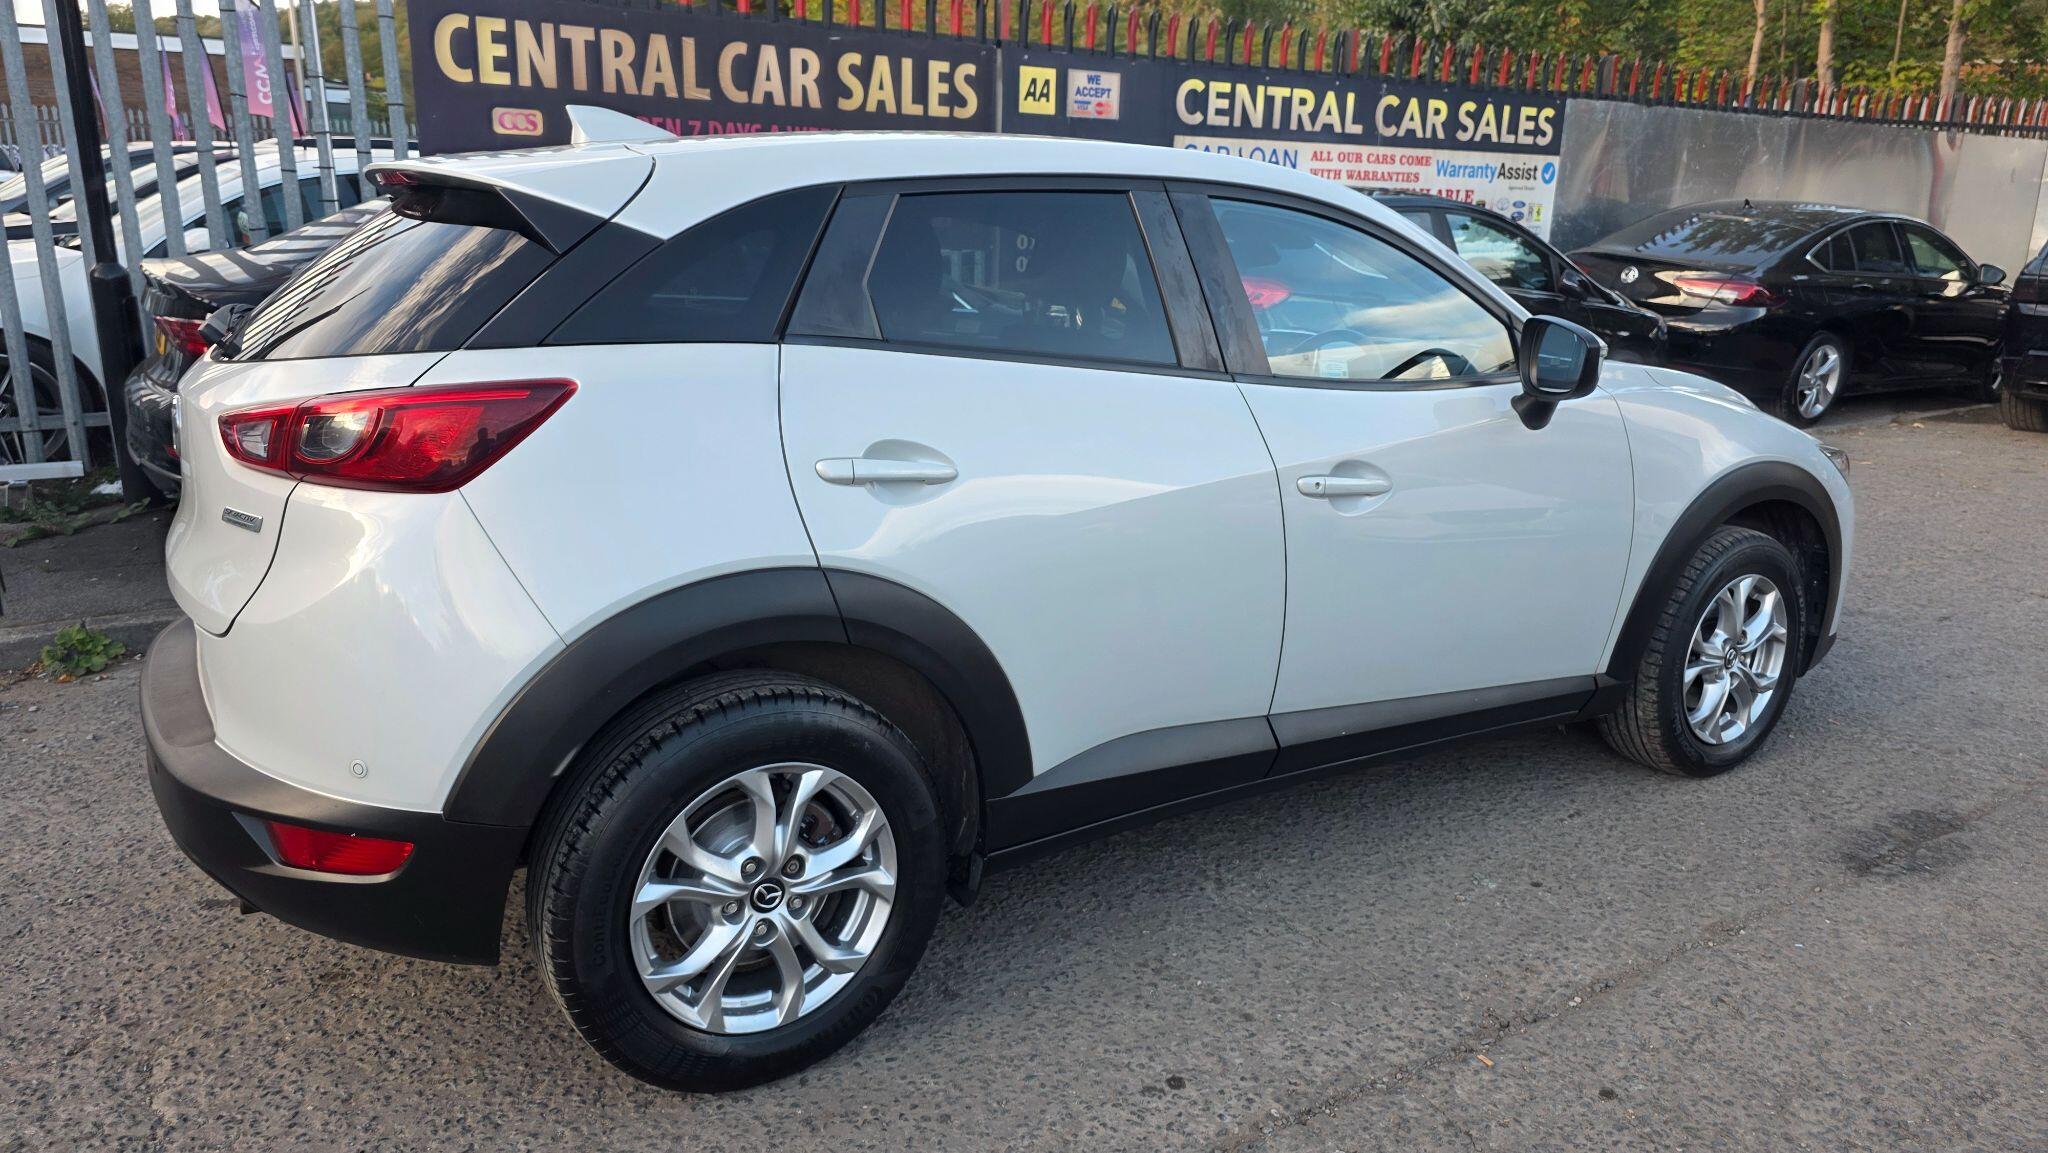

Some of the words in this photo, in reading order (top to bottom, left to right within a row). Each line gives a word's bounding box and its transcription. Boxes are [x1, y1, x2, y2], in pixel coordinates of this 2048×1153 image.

[434, 13, 711, 100] CENTRAL
[718, 41, 822, 109] CAR
[837, 52, 978, 119] SALES
[1086, 74, 1101, 86] WE
[1024, 78, 1050, 103] AA
[1075, 86, 1112, 99] ACCEPT
[1176, 78, 1363, 134] CENTRAL
[1375, 94, 1448, 139] CAR
[1455, 101, 1556, 147] SALES
[636, 115, 681, 138] EN
[1310, 150, 1333, 162] ALL
[1338, 151, 1363, 164] OUR
[1367, 153, 1396, 165] CARS
[1400, 155, 1432, 167] COME
[1310, 168, 1341, 180] WITH
[1346, 169, 1420, 183] WARRANTIES
